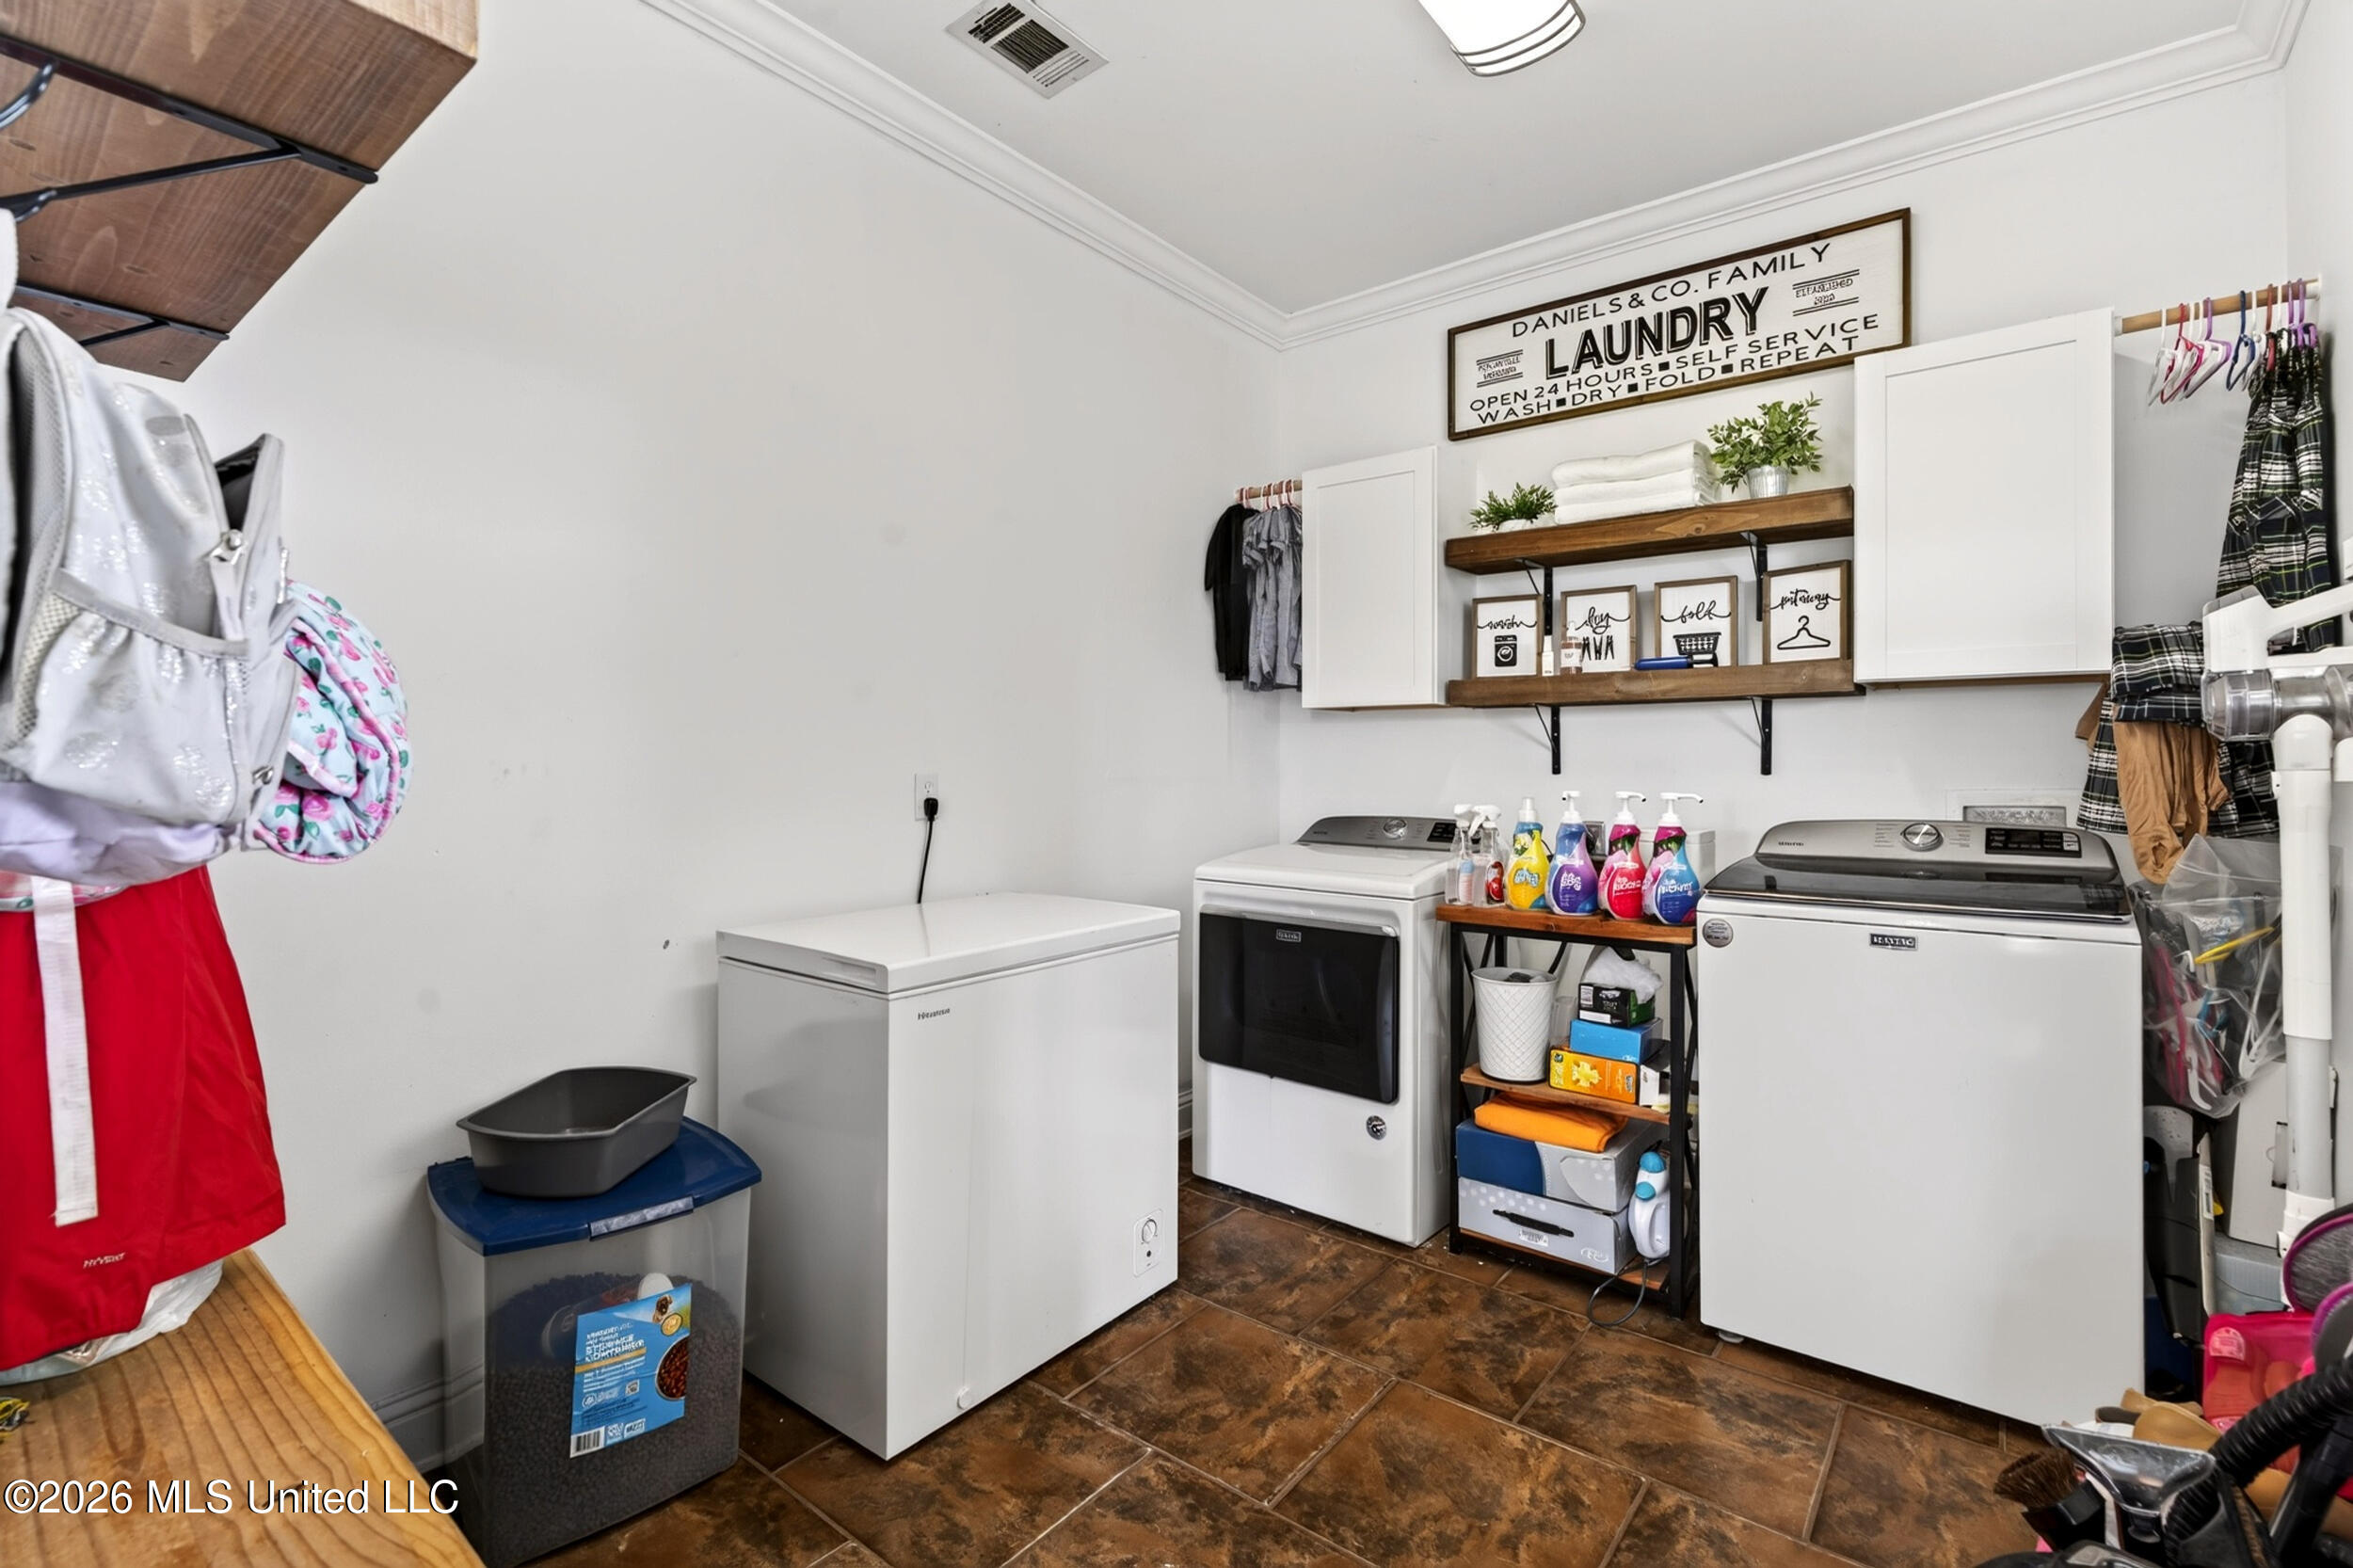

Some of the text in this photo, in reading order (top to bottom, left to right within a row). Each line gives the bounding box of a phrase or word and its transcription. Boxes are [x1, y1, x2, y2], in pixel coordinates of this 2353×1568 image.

[1513, 243, 1831, 338] DANIELS & CO. FAMILY
[1545, 286, 1769, 380] LAUNDRY
[1470, 313, 1880, 411] OPEN 24 HOURS SELF SERVICE
[1477, 336, 1860, 424] WASH DRY FOLD REPEAT
